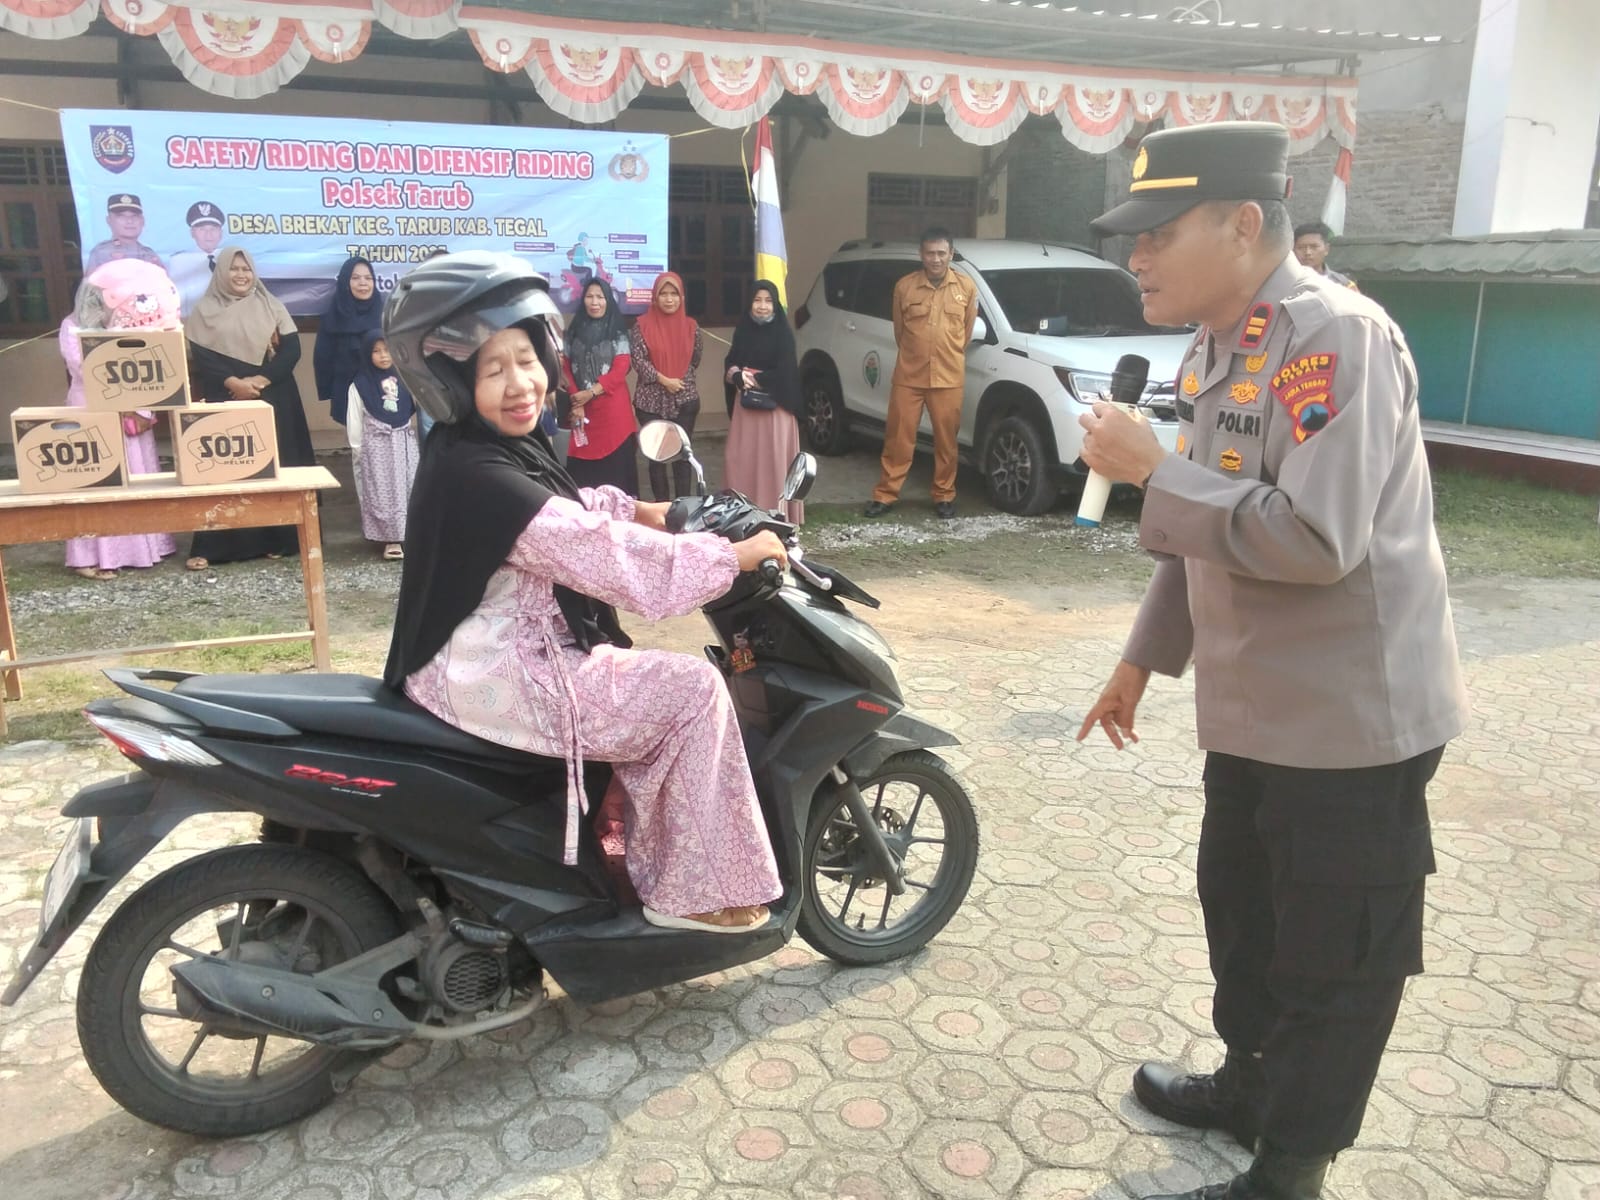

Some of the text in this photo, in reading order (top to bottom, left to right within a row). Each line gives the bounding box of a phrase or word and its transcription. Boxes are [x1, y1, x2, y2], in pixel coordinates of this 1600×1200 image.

[167, 136, 593, 179] SAFETY RIDING DAN DIFENSIF RIDING
[322, 177, 472, 210] Polsek Tarub
[228, 214, 548, 236] DESA BREKAT KEC. TARUB KAB. TEGAL
[347, 244, 407, 263] TAHUN
[105, 359, 164, 384] SOJI
[1272, 355, 1329, 388] POLRES
[1216, 411, 1261, 437] POLRI
[39, 441, 100, 466] SOJI
[200, 435, 254, 458] SOJI
